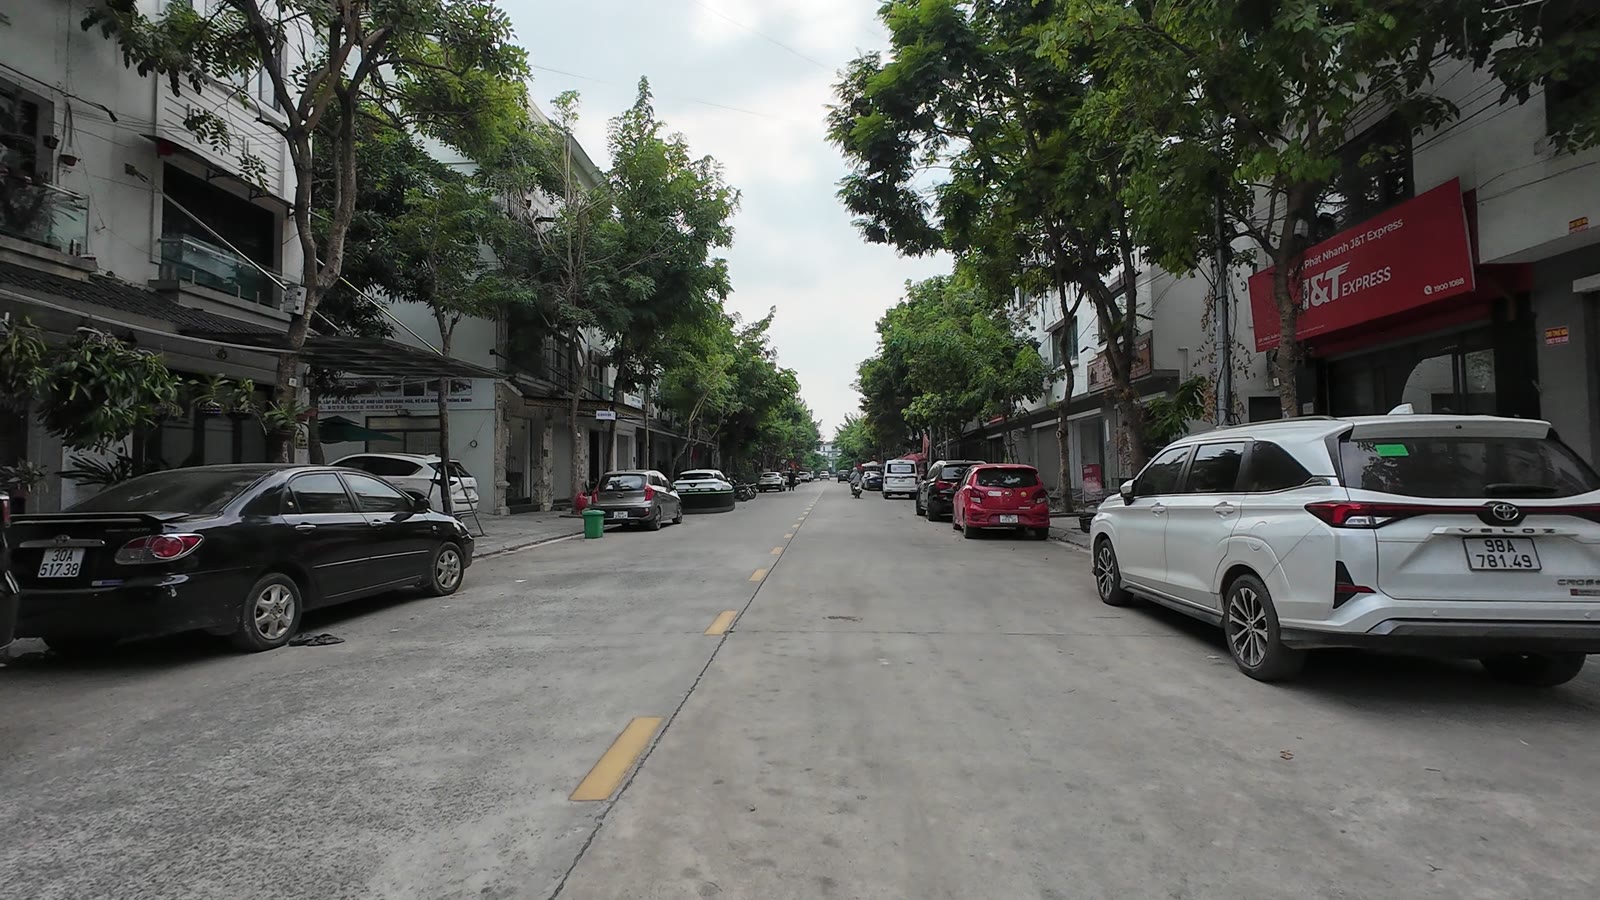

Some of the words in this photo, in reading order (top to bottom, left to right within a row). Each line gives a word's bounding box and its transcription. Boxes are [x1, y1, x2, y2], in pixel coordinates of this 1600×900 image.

[1304, 255, 1322, 270] Phát
[1322, 243, 1349, 262] Nhanh
[1350, 235, 1366, 250] J&T
[1367, 218, 1404, 241] Express
[1342, 266, 1392, 297] EXPRESS
[1433, 282, 1449, 292] 1900
[1484, 539, 1516, 553] 98A
[51, 549, 73, 562] 30A
[1475, 554, 1533, 569] 781.49
[39, 563, 79, 577] 517.38
